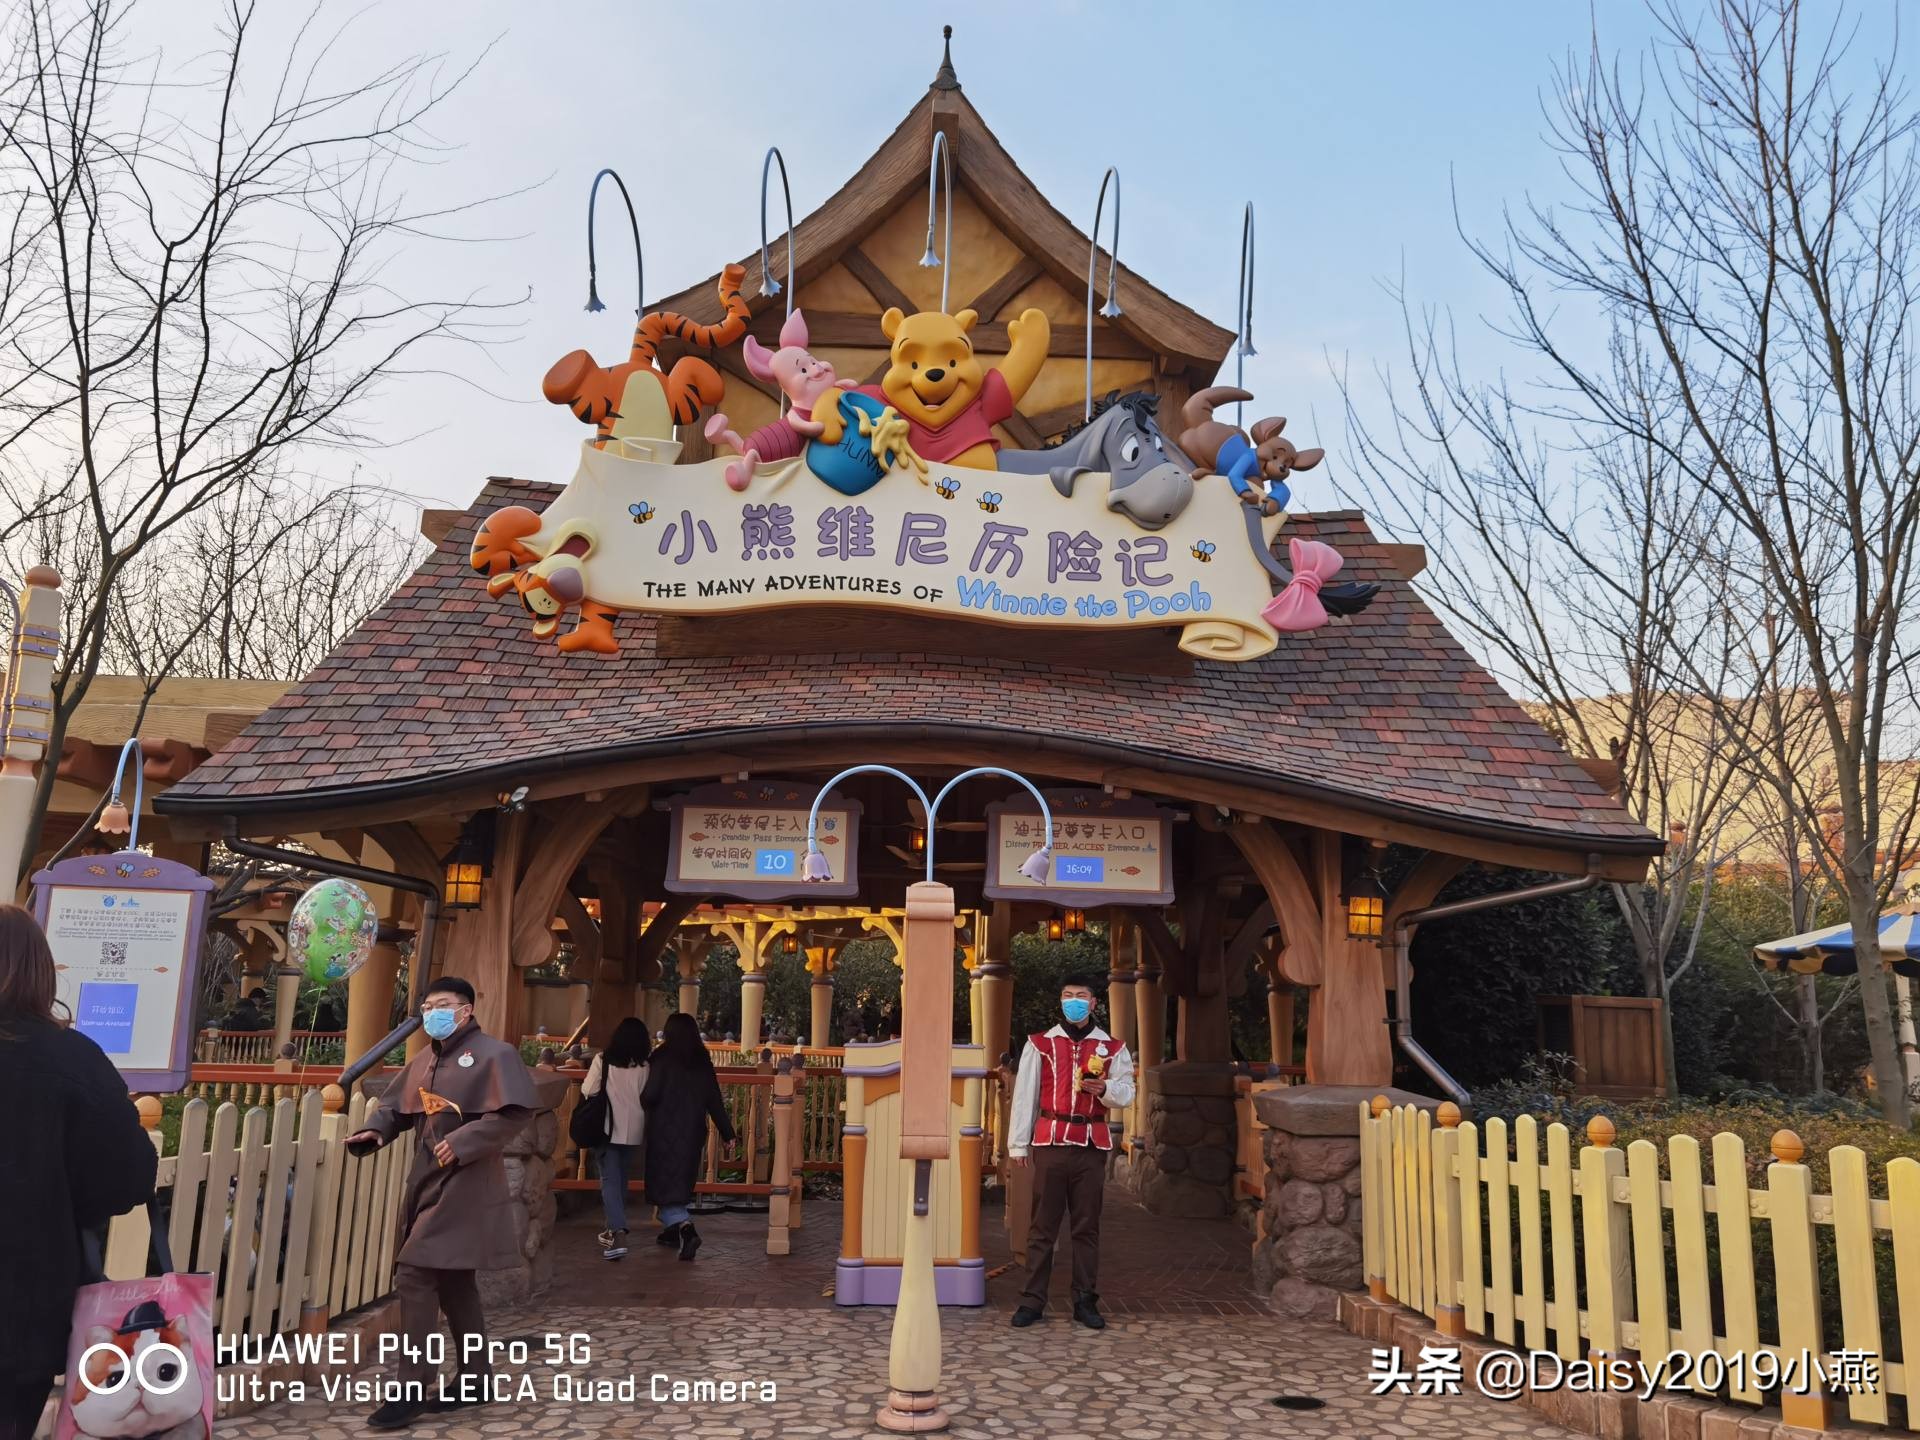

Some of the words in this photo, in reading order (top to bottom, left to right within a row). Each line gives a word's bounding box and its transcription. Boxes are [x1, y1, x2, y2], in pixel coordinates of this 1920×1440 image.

[658, 502, 1174, 587] 小熊维尼历险记
[643, 581, 687, 598] THE
[697, 577, 755, 598] MANY
[764, 574, 902, 595] ADVENTURES
[913, 585, 944, 602] OF
[957, 575, 1067, 616] Winnie
[1074, 594, 1118, 618] the
[1123, 580, 1212, 619] Pooh
[754, 834, 773, 842] Pass
[1005, 839, 1030, 849] Disney
[1071, 841, 1105, 852] ACCESS
[712, 860, 729, 870] Wait
[732, 861, 749, 870] Time
[763, 853, 787, 871] 10
[1065, 863, 1092, 876] 16:04
